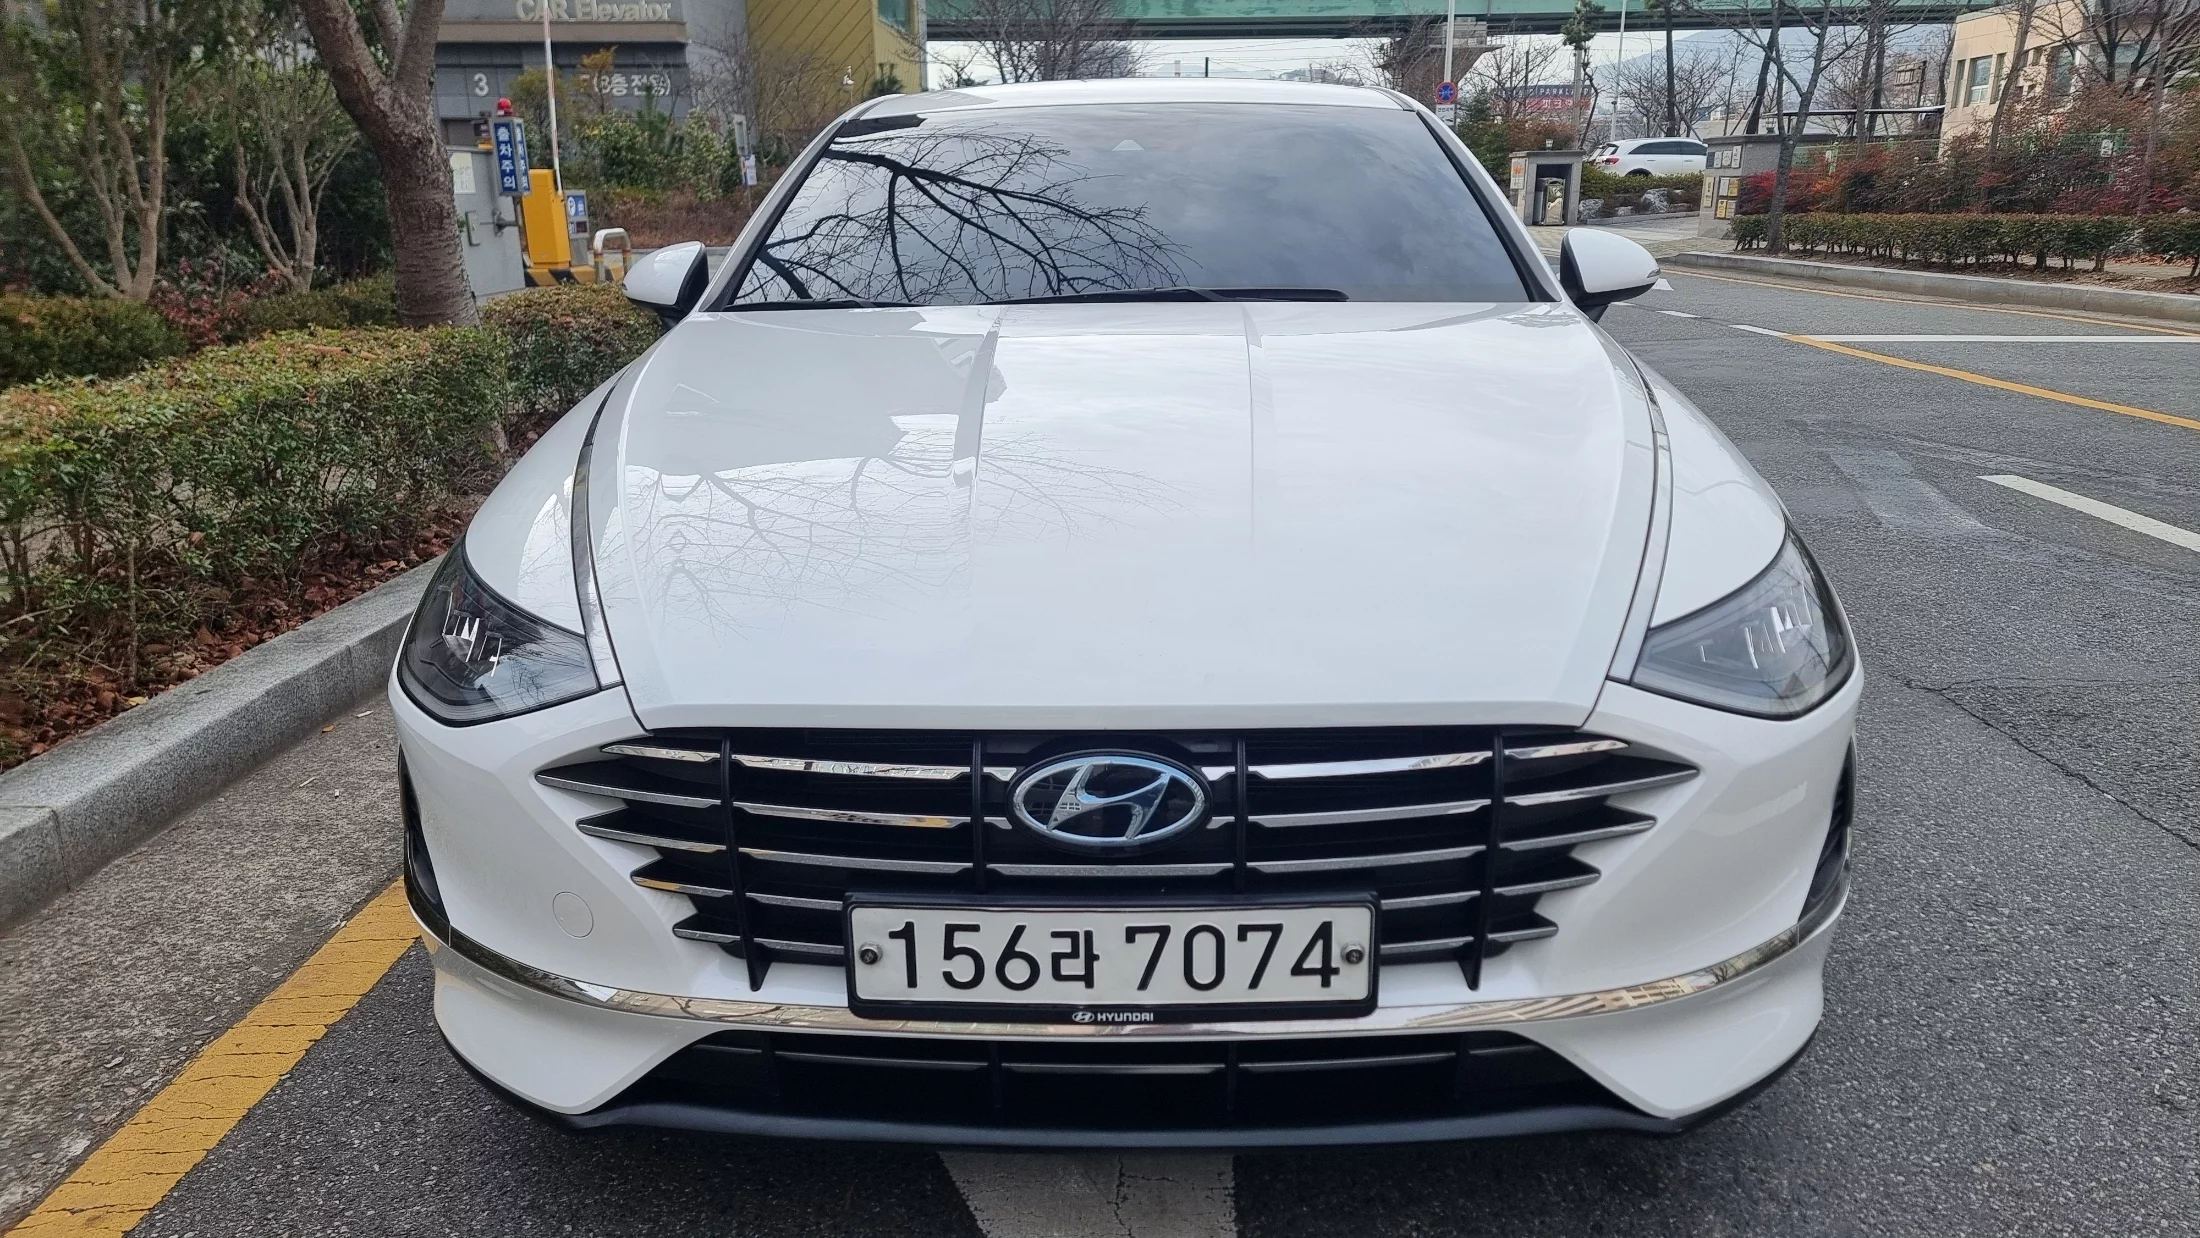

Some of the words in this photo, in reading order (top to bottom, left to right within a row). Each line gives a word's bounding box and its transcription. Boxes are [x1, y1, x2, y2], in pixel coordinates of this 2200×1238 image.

[516, 0, 569, 20] CAR
[576, 0, 671, 20] Elevator
[474, 72, 489, 96] 3
[497, 126, 516, 189] 출차주의
[889, 920, 1100, 991] 156라
[1124, 920, 1340, 991] 7074
[1097, 1012, 1154, 1022] HYUNDAI
